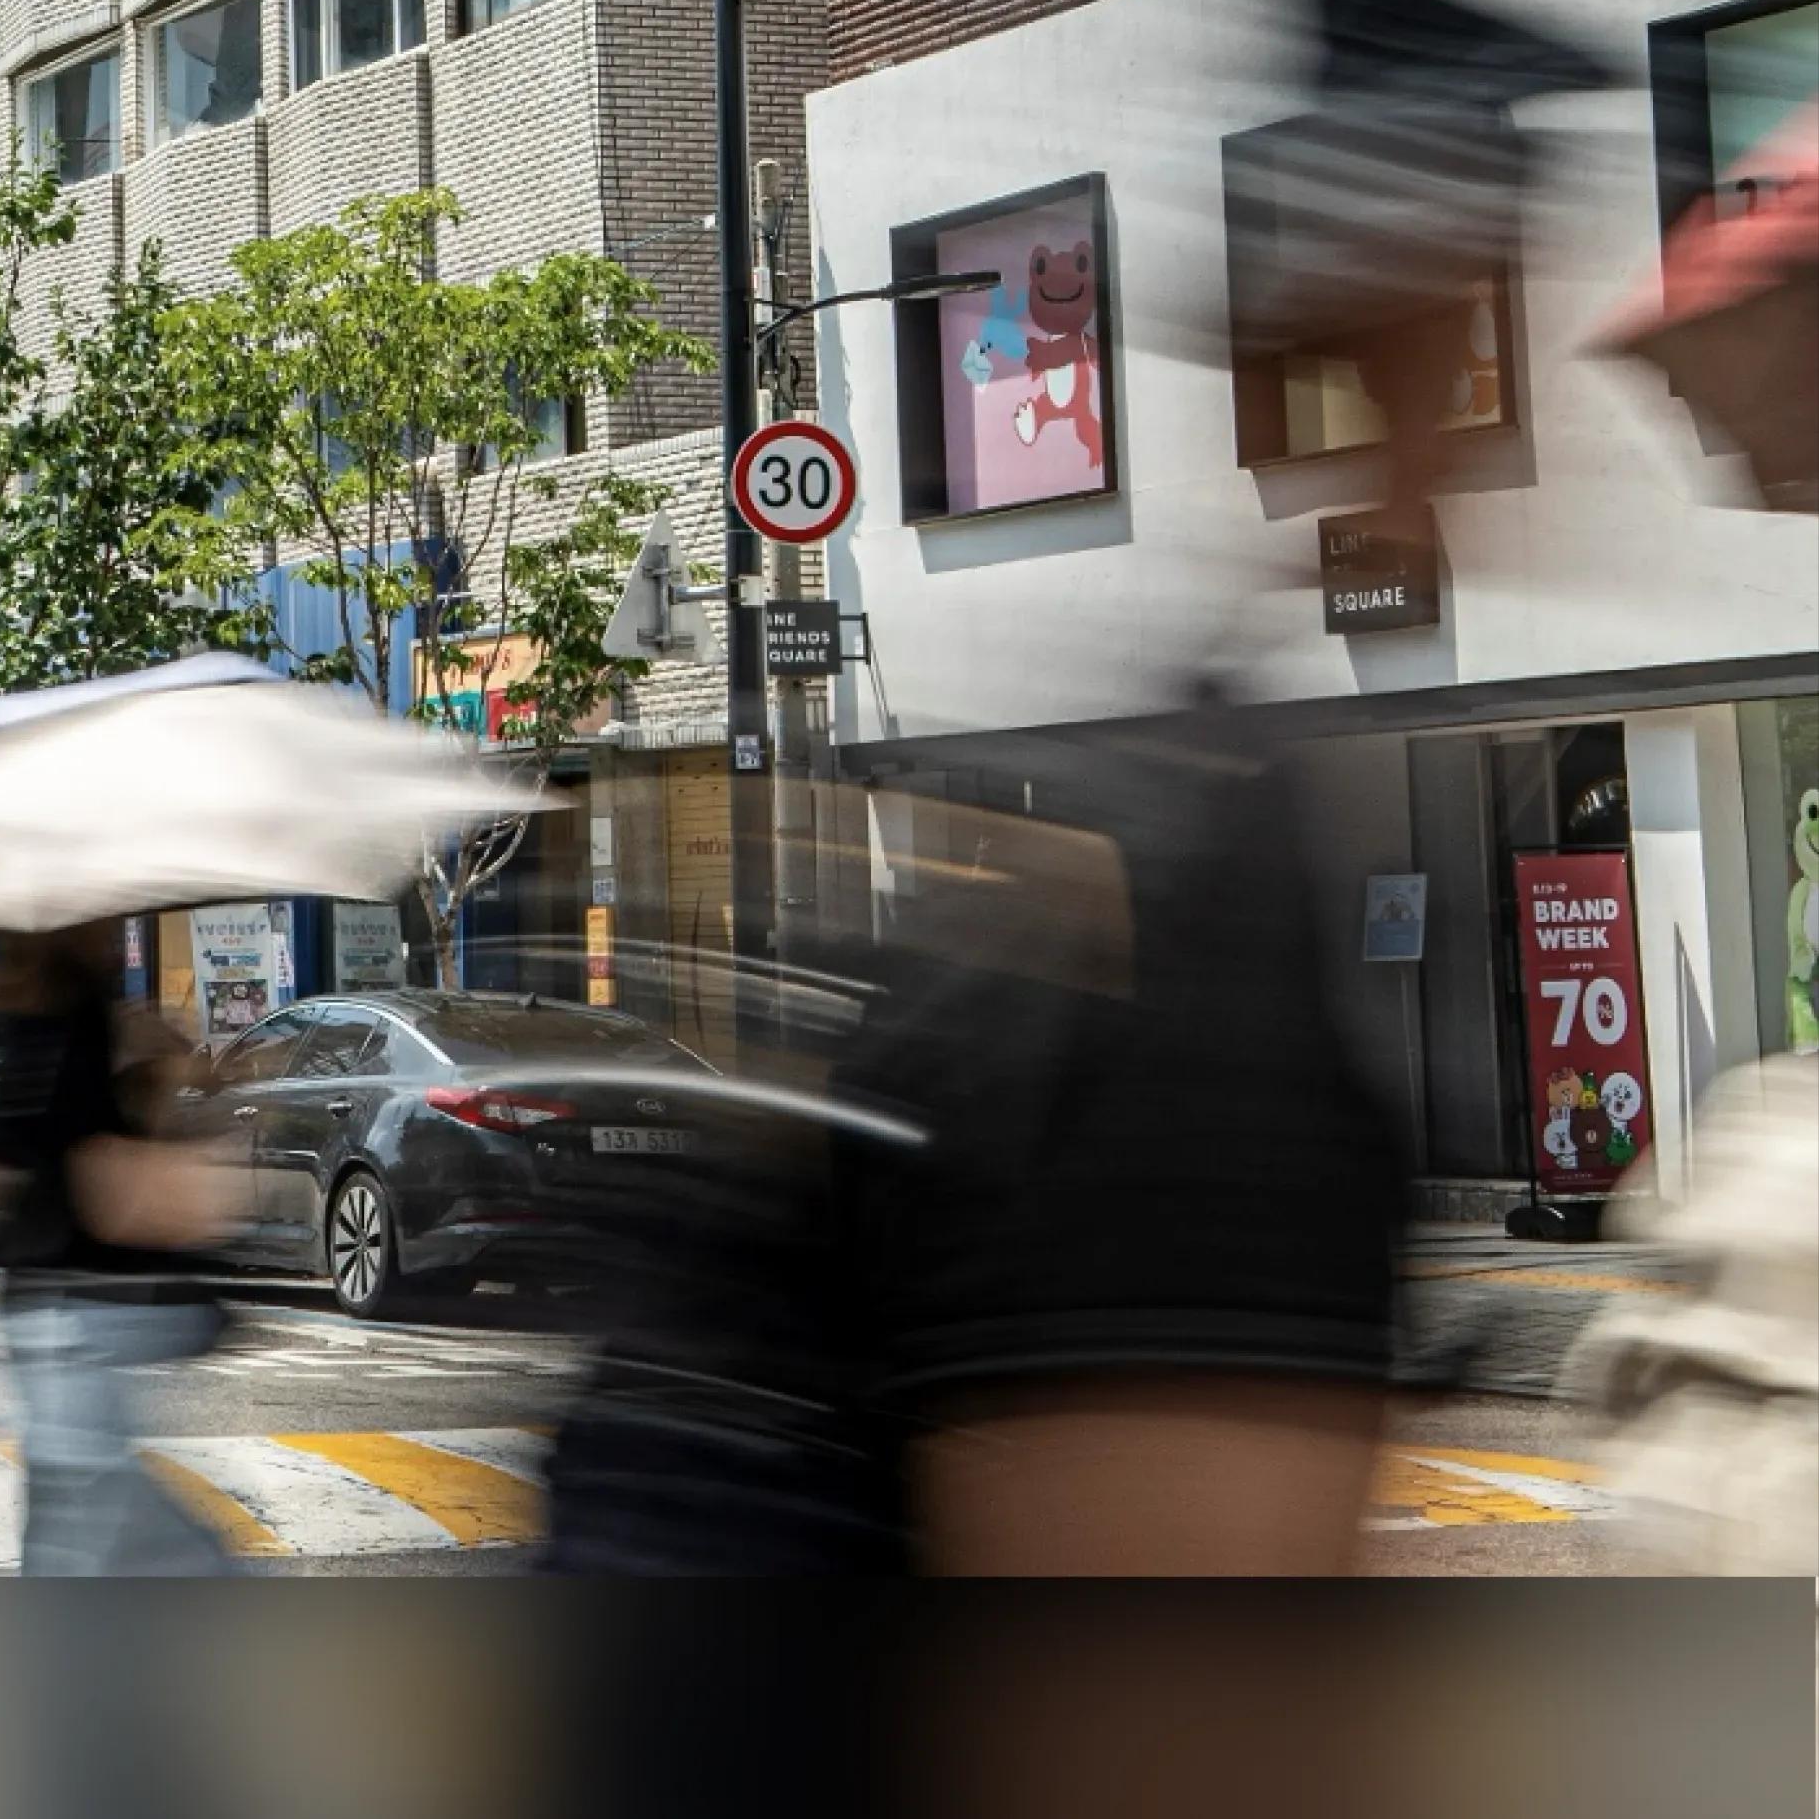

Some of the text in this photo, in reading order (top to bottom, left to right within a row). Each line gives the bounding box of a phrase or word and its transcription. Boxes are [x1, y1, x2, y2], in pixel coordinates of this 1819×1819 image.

[758, 455, 831, 511] 30
[1333, 586, 1406, 613] SQUARE
[767, 612, 796, 626] INE
[767, 631, 830, 644] RIENDS
[768, 649, 827, 662] QUARE
[1534, 898, 1619, 922] BRAND
[1535, 927, 1610, 950] WEEK
